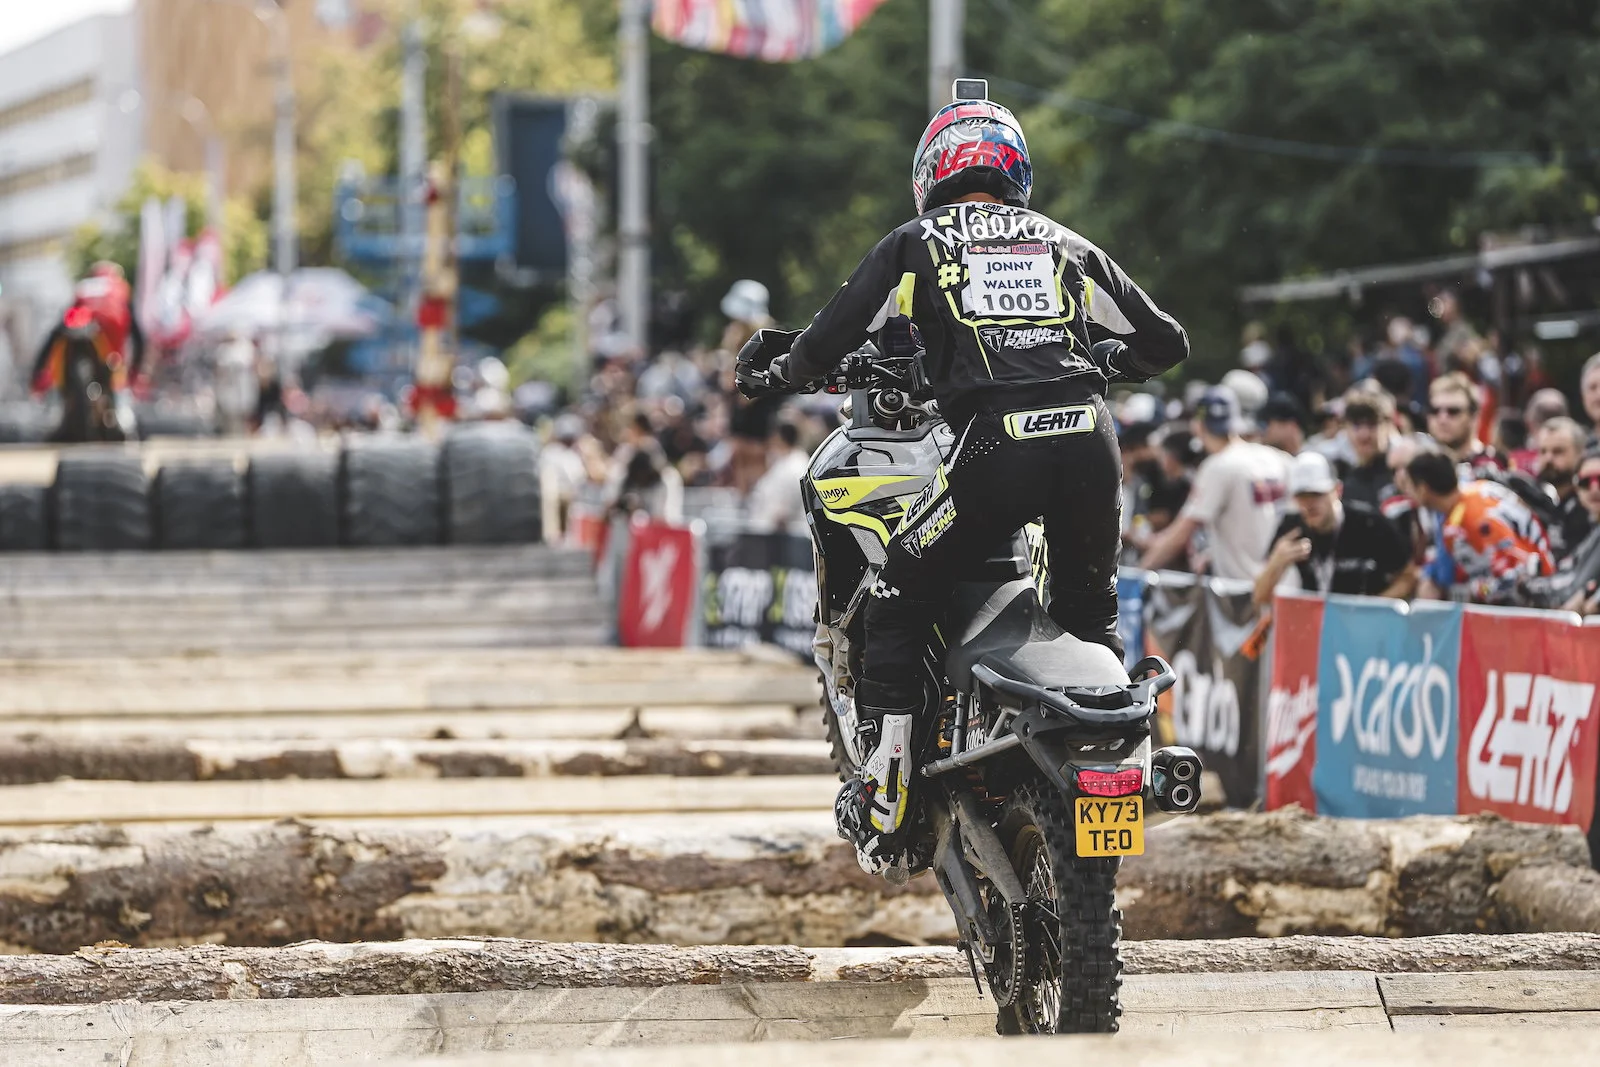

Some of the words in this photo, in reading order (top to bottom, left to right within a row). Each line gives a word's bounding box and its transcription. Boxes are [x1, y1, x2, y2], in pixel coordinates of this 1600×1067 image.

[935, 141, 1025, 180] LEATT
[982, 203, 1004, 212] LEATT
[985, 261, 1033, 274] JONNY
[983, 278, 1042, 290] WALKER
[983, 292, 1050, 311] 1005
[1004, 335, 1063, 347] RACING
[1006, 327, 1064, 339] TRIUMPH
[1023, 410, 1086, 433] LEATT
[819, 486, 850, 499] UMPH
[917, 495, 955, 538] TRIUMPH
[919, 507, 957, 549] RACING
[1080, 801, 1139, 824] KY73
